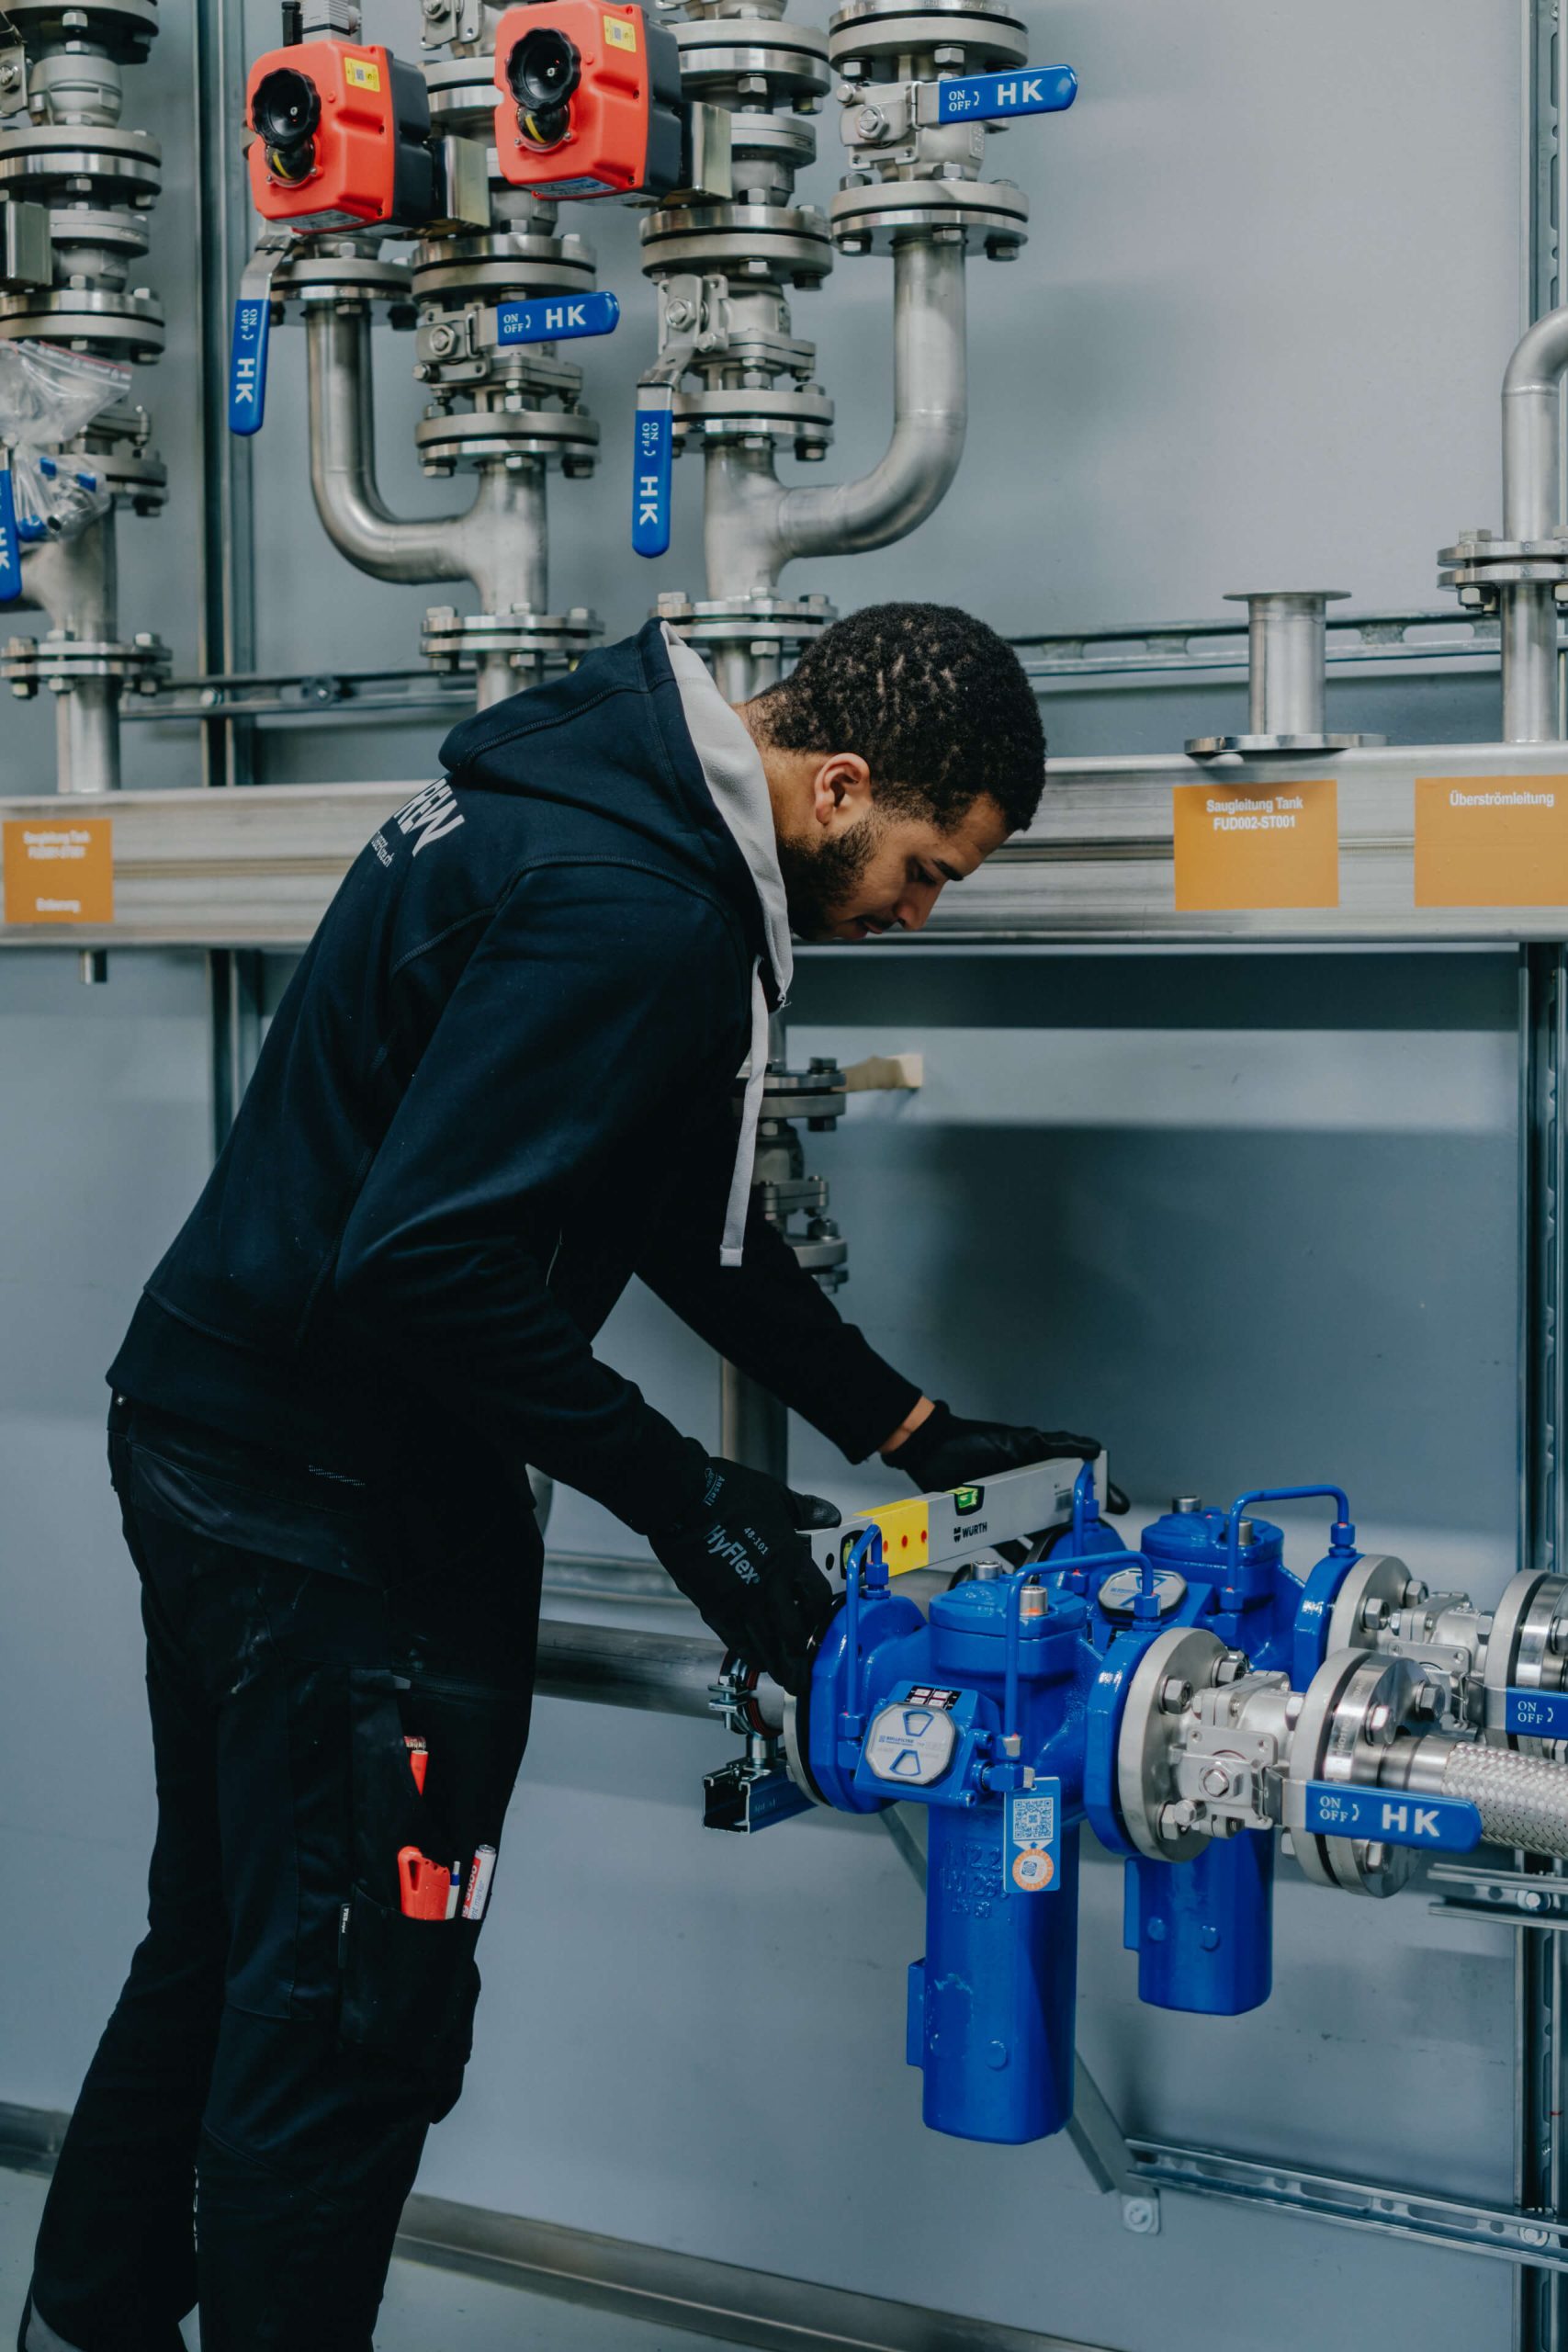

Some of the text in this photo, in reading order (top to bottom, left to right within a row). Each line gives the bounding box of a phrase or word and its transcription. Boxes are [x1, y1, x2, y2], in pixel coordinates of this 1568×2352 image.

[948, 90, 965, 101] ON
[998, 79, 1043, 106] HK
[948, 100, 971, 111] OFF
[241, 309, 249, 332] OFF
[249, 309, 258, 325] ON
[503, 313, 519, 323] ON
[546, 304, 587, 329] HK
[503, 322, 525, 334] OFF
[235, 358, 255, 403] HK
[642, 423, 650, 447] OFF
[650, 423, 659, 440] ON
[639, 476, 659, 526] HK
[1206, 796, 1303, 814] Saugleitung Tank
[1450, 789, 1554, 808] Überströmleitung
[1213, 815, 1295, 831] FUD002-ST001
[744, 1527, 769, 1555] 48-101
[1517, 1701, 1537, 1713] ON
[1517, 1713, 1543, 1724] OFF
[1320, 1795, 1341, 1809] ON
[1320, 1808, 1348, 1822] OFF
[1382, 1804, 1440, 1837] HK
